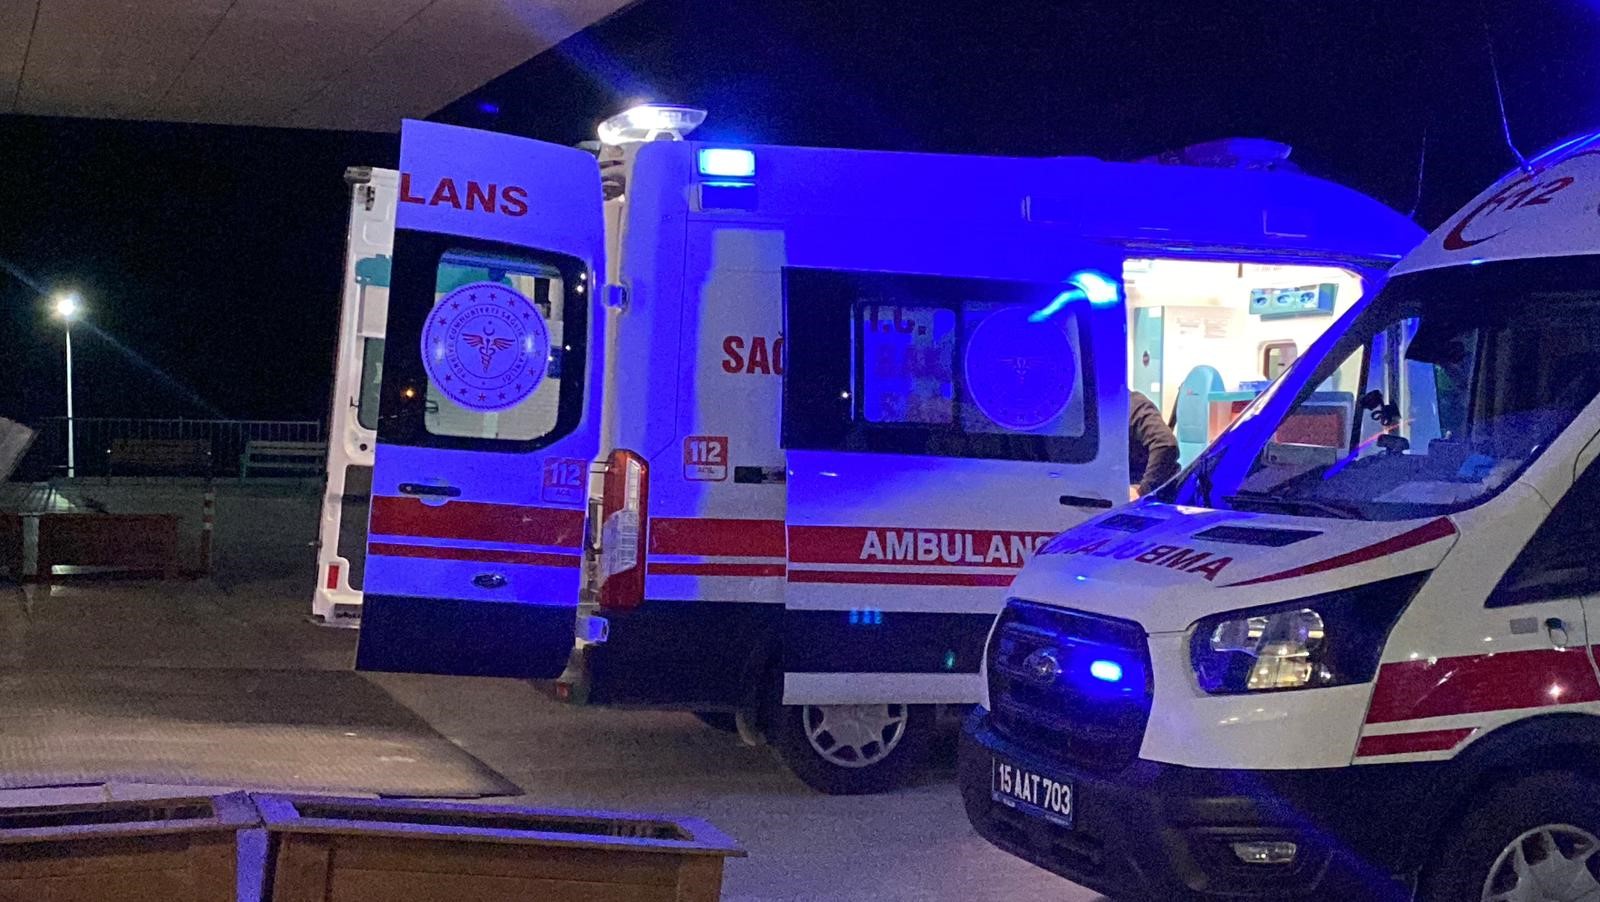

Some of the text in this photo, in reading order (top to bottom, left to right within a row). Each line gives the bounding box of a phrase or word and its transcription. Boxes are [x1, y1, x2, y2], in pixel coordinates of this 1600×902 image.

[400, 173, 528, 216] LANS
[691, 440, 722, 463] 112
[551, 462, 581, 486] 112
[999, 763, 1071, 815] 15 AAT 703
